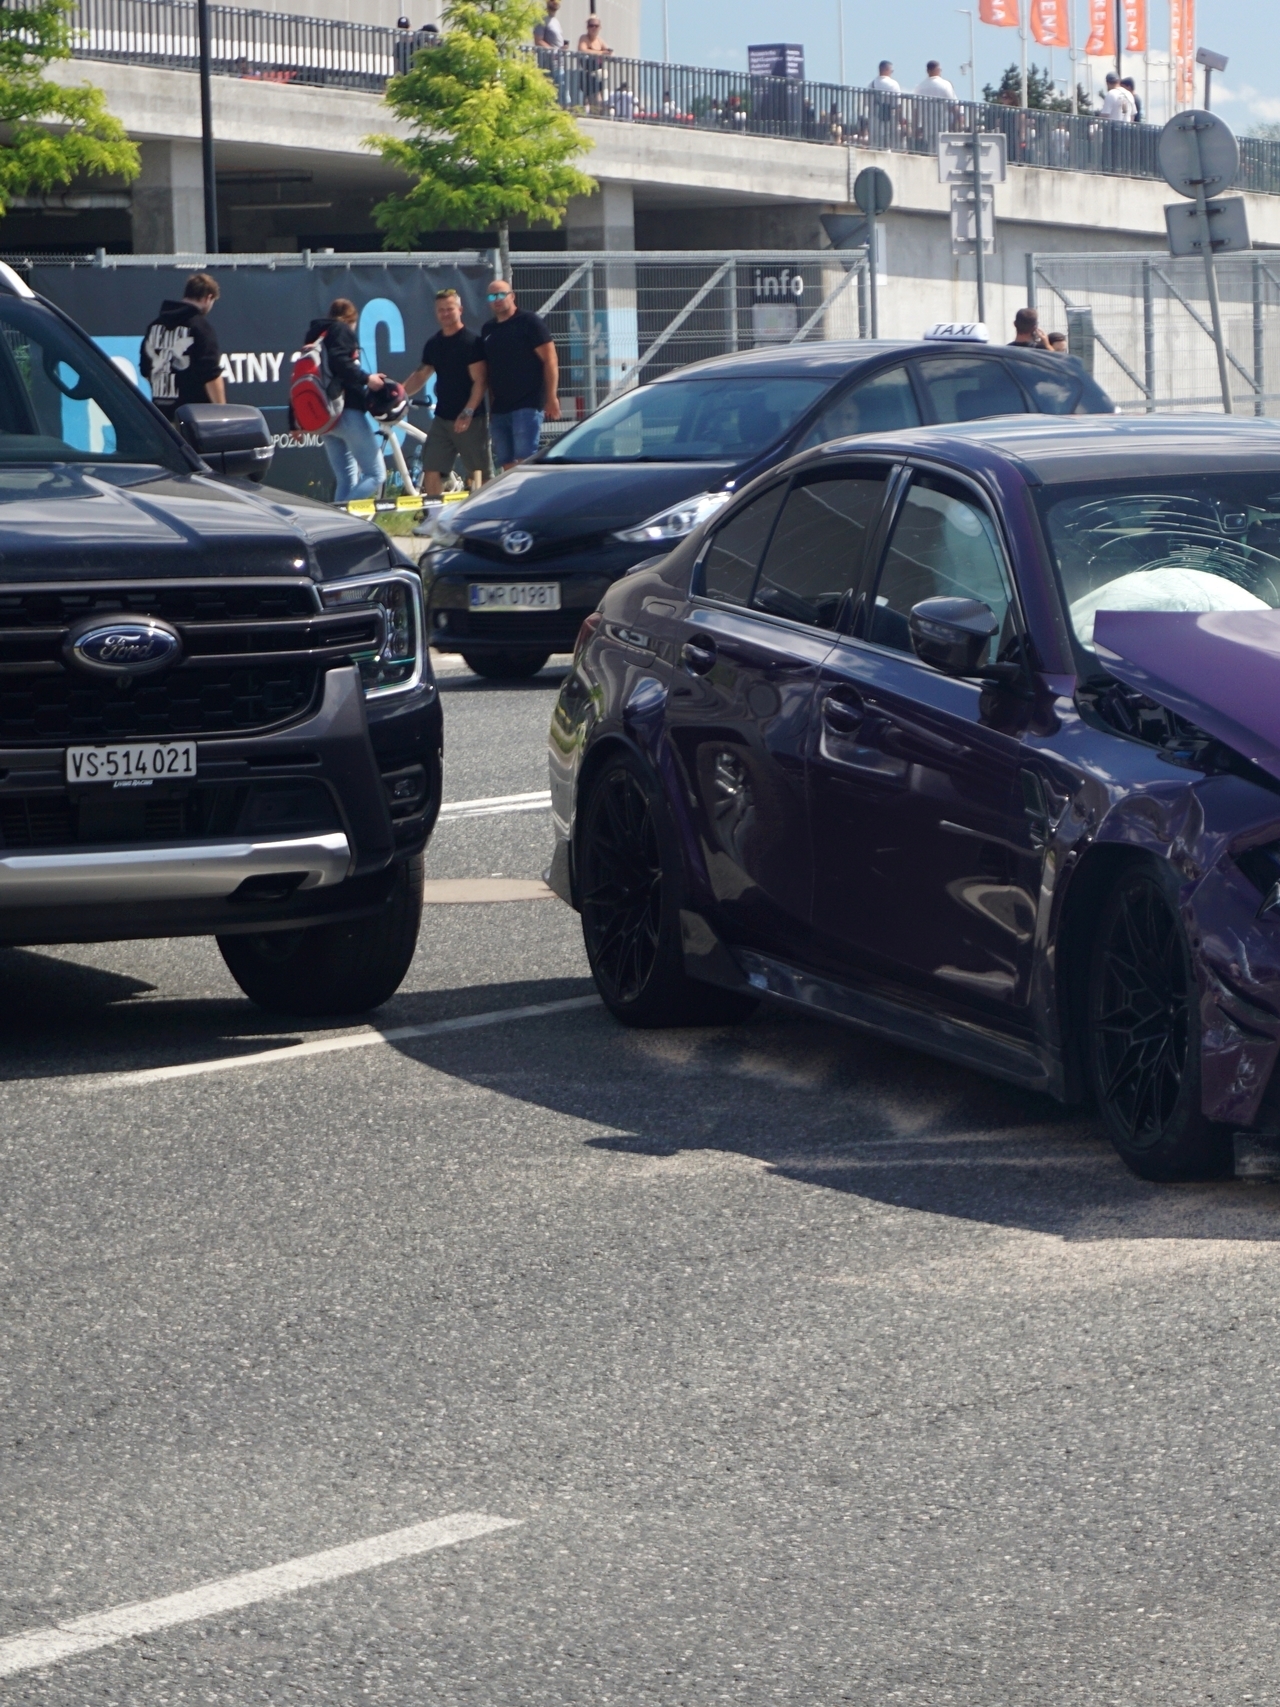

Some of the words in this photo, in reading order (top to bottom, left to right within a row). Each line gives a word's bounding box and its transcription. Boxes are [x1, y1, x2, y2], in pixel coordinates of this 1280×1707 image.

[755, 269, 804, 296] info
[932, 323, 977, 336] TAXI
[100, 634, 155, 660] Ford
